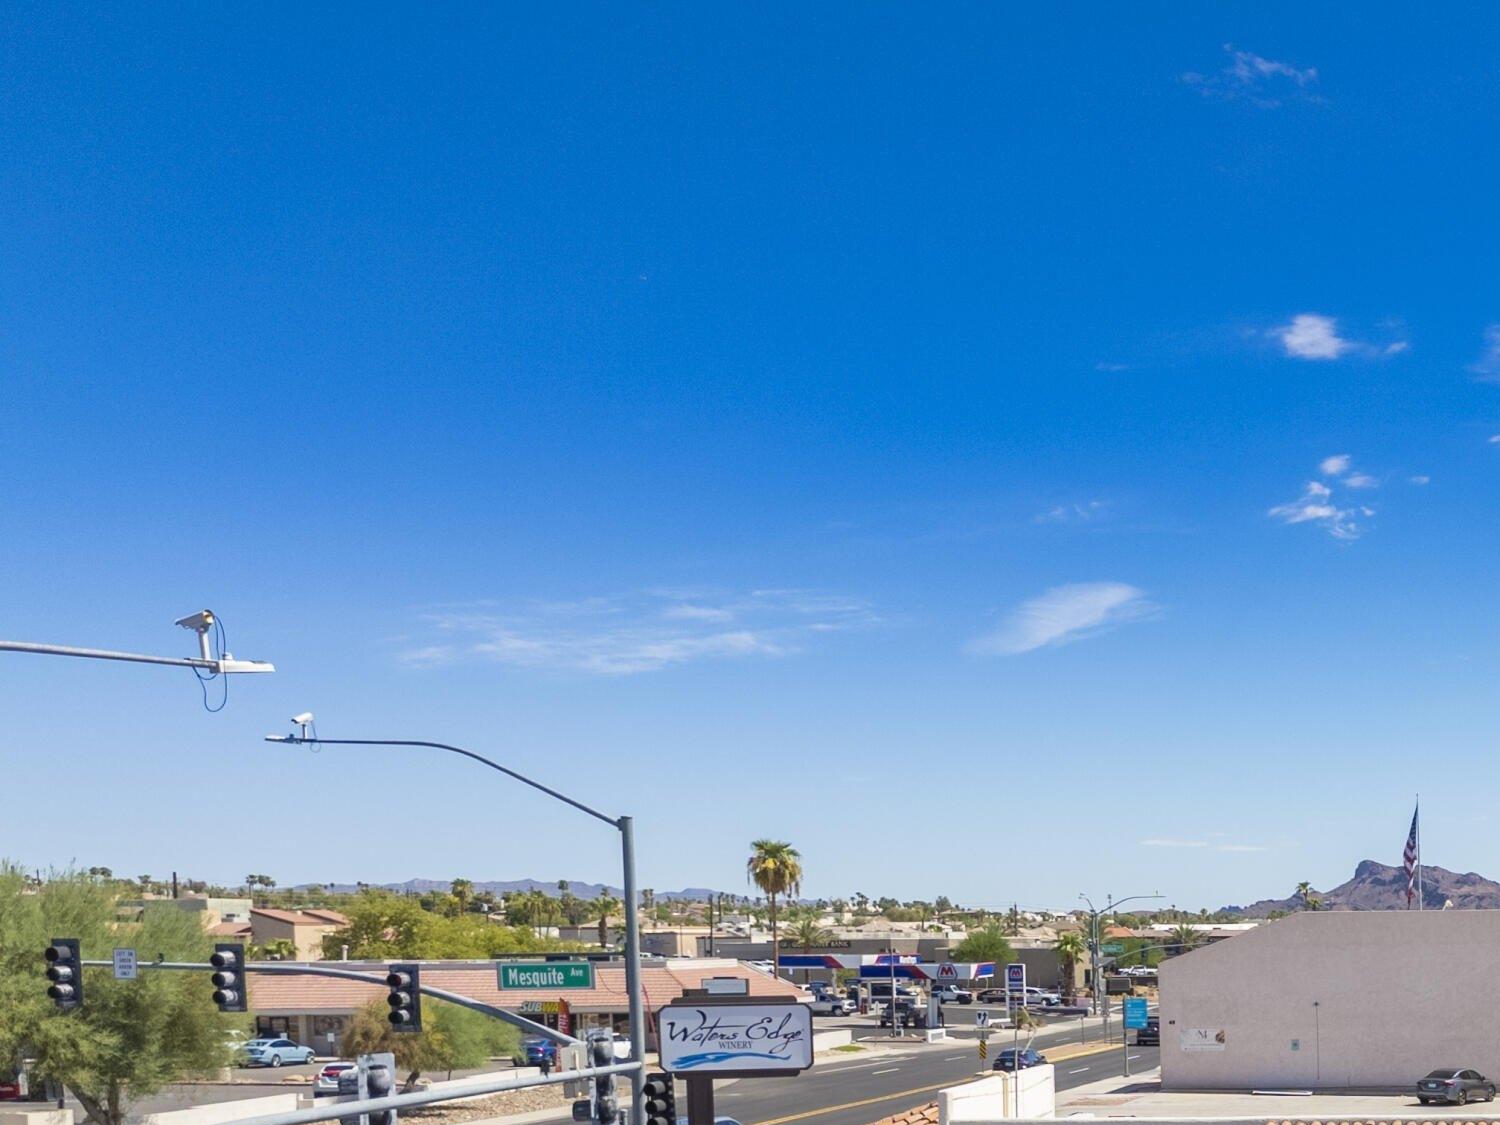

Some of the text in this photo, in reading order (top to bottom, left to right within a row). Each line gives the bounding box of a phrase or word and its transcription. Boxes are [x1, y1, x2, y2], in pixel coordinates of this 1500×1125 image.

[508, 967, 584, 987] Mesquite Ave
[521, 1002, 560, 1012] SUBWA
[667, 1009, 804, 1054] Waters Edge
[718, 1041, 754, 1050] WINERY
